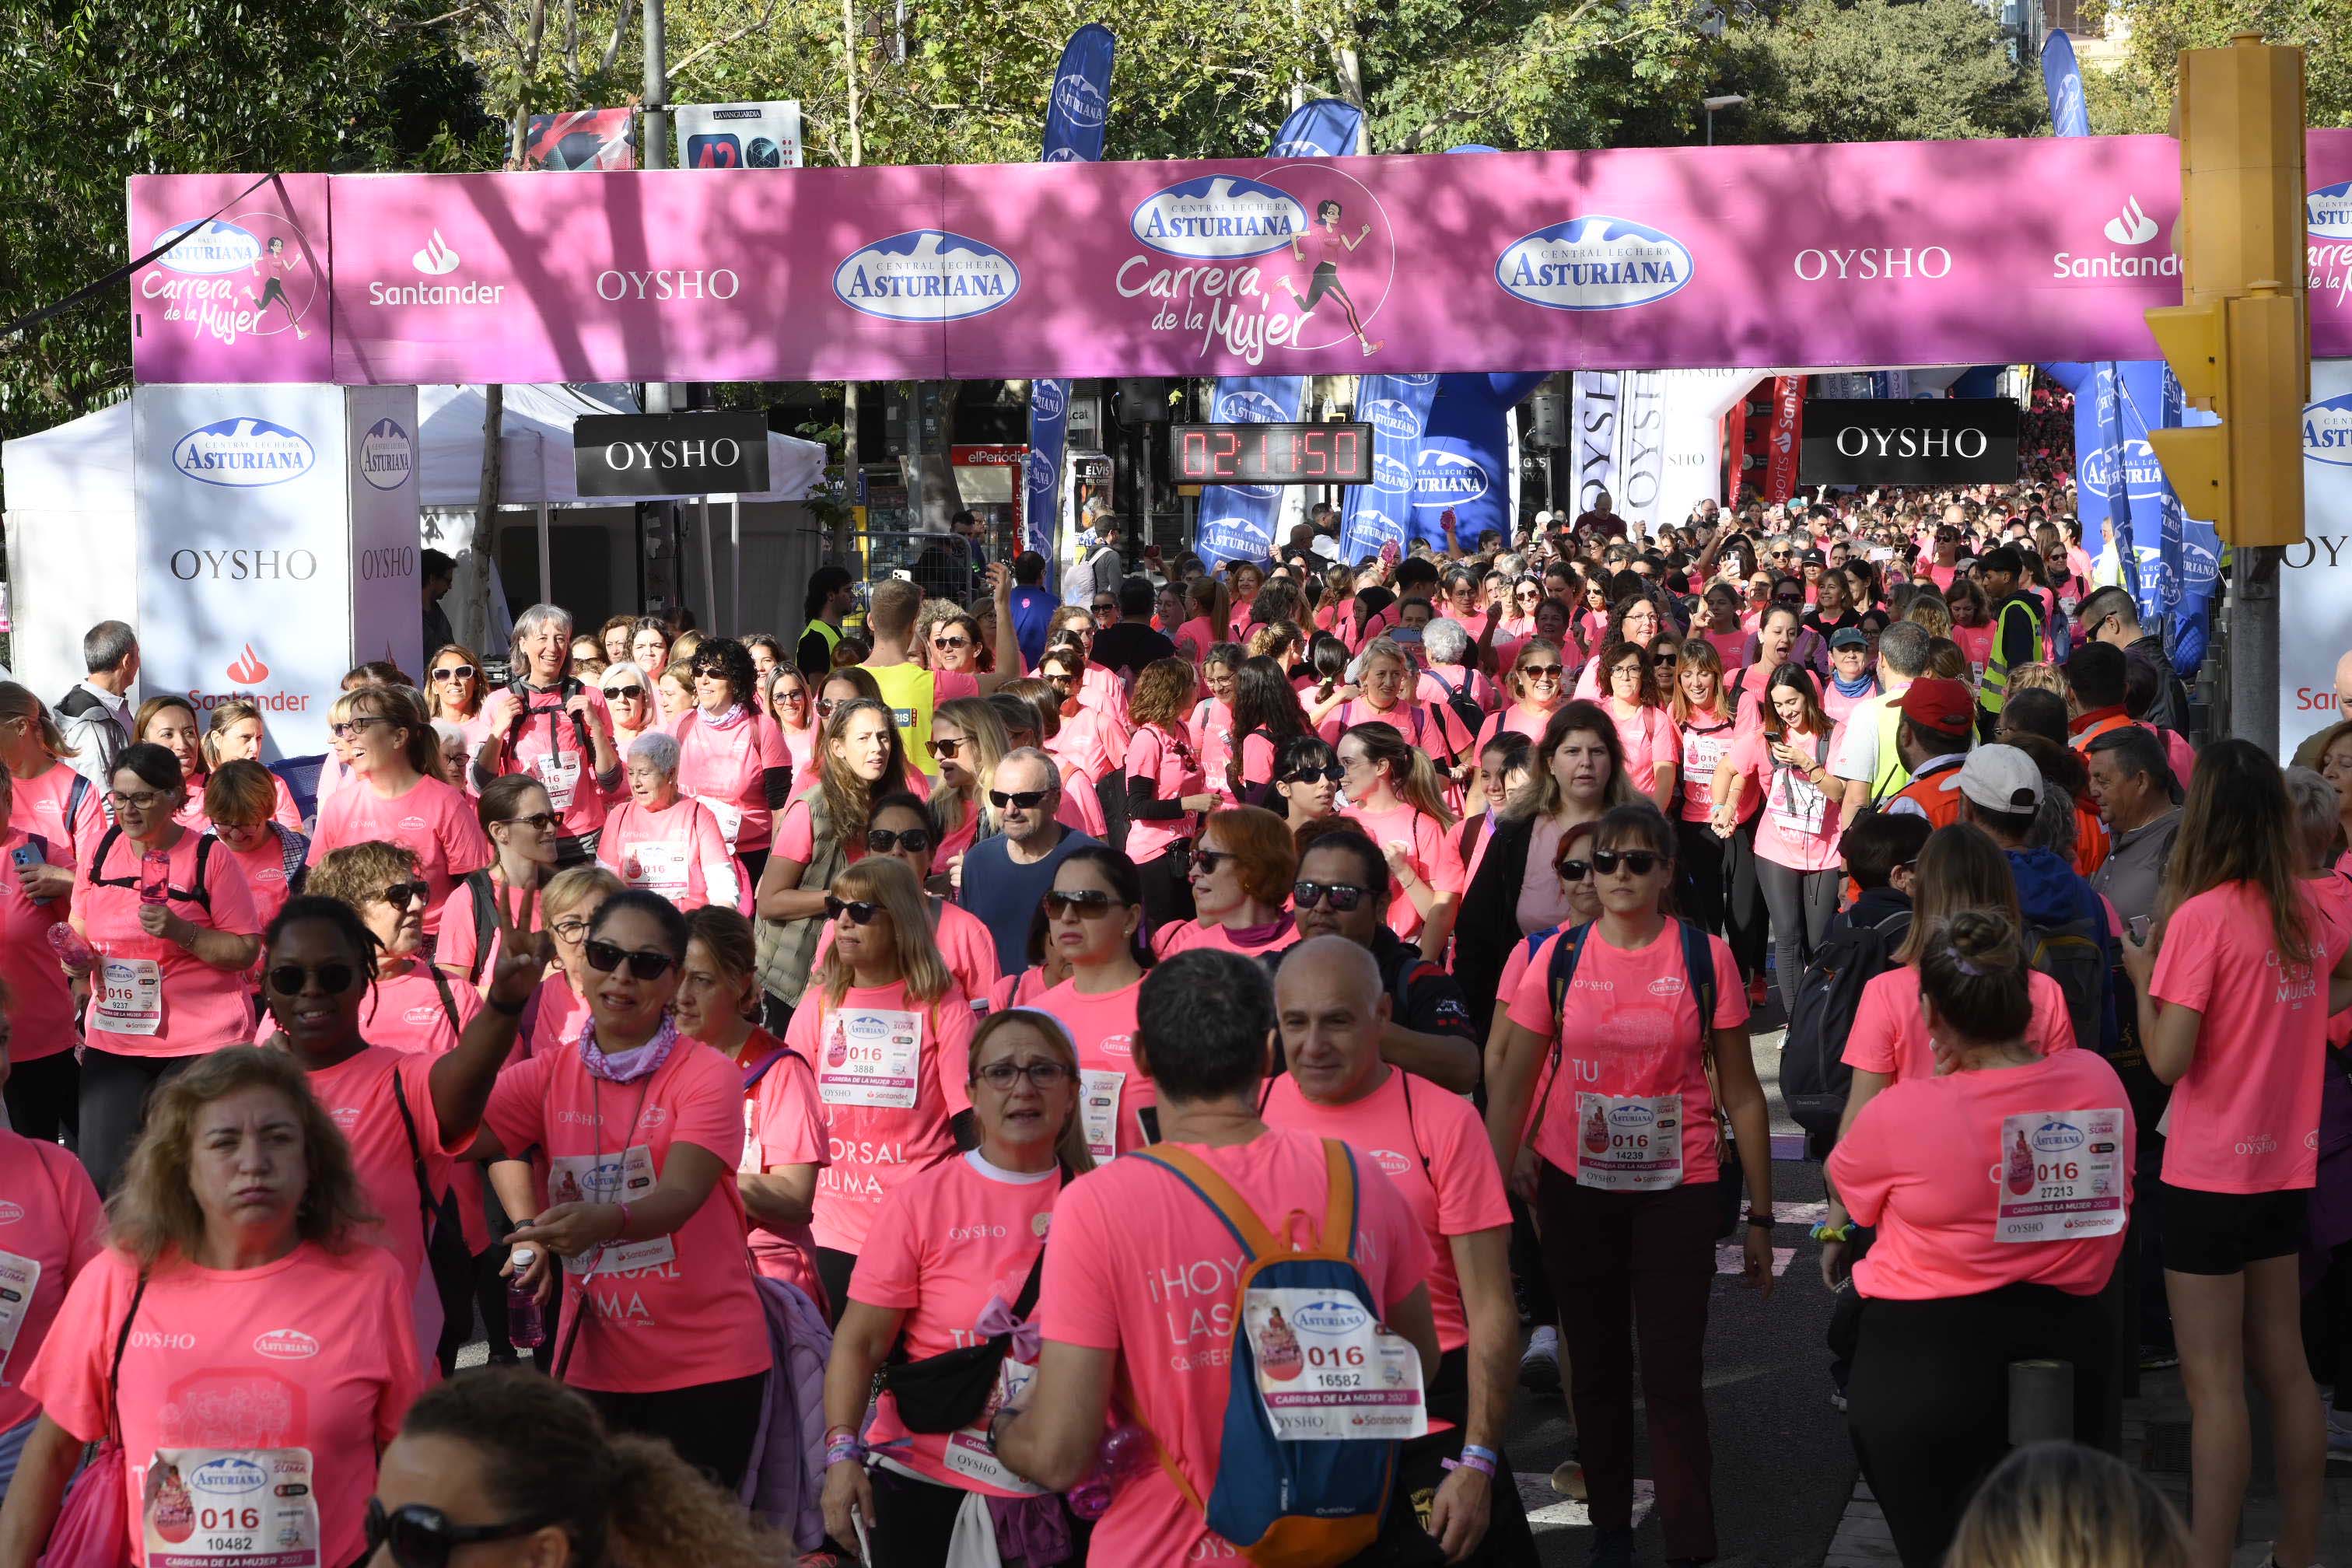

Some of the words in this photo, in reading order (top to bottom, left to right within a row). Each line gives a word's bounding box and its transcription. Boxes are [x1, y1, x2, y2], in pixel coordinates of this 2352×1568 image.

[724, 110, 761, 119] VANGUARDIA
[1171, 204, 1227, 212] CENTRAL
[1233, 203, 1289, 212] LECHERA
[1144, 206, 1293, 239] ASTURIANA
[159, 240, 253, 261] ASTURIANA
[1541, 249, 1602, 259] CENTRAL
[1608, 247, 1671, 257] LECHERA
[1510, 252, 1678, 287] ASTURIANA
[1794, 246, 1951, 281] OYSHO
[142, 271, 232, 299] Carrera
[596, 268, 739, 302] OYSHO
[848, 264, 1006, 299] ASTURIANA
[1115, 255, 1261, 298] Carrera
[2326, 268, 2340, 289] la
[369, 282, 504, 306] Santander
[164, 301, 180, 321] de
[184, 301, 196, 321] la
[1151, 301, 1178, 330] de
[1185, 299, 1203, 330] la
[194, 298, 268, 345] Mujer
[1200, 294, 1316, 366] Mujer
[1364, 409, 1415, 436] ASTURIANA
[1836, 426, 1987, 458] OYSHO
[184, 443, 305, 469] ASTURIANA
[364, 445, 409, 472] ASTURIANA
[605, 438, 739, 471] OYSHO
[1183, 432, 1357, 475] 02:11:50
[1086, 465, 1109, 476] ELVIS
[1205, 528, 1267, 558] ASTURIANA
[170, 549, 317, 580] OYSHO
[362, 546, 413, 580] OYSHO
[109, 988, 132, 999] 016
[1574, 979, 1613, 991] OYSHO
[852, 1024, 886, 1035] ASTURIANA
[849, 1047, 883, 1062] 016
[852, 1064, 874, 1073] 3888
[1572, 1059, 1598, 1083] TU
[824, 1088, 851, 1097] OYSHO
[875, 1090, 908, 1101] Santander
[1612, 1113, 1651, 1122] ASTURIANA
[1612, 1135, 1649, 1148] 016
[2035, 1136, 2080, 1146] ASTURIANA
[2235, 1142, 2277, 1156] OYSHO
[1587, 1172, 1616, 1183] OYSHO
[2037, 1162, 2079, 1182] 016
[2041, 1186, 2074, 1199] 27213
[950, 1225, 1007, 1241] OYSHO
[2007, 1222, 2044, 1234] OYSHO
[2074, 1218, 2115, 1228] Santander
[626, 1246, 663, 1260] Santander
[1167, 1303, 1232, 1345] LAS
[1300, 1312, 1360, 1327] ASTURIANA
[131, 1331, 195, 1350] OYSHO
[257, 1339, 314, 1353] ASTURIANA
[1308, 1346, 1364, 1367] 016
[1318, 1374, 1361, 1388] 16582
[1275, 1395, 1320, 1404] CARRERA
[1323, 1395, 1337, 1403] DE
[1339, 1394, 1352, 1402] LA
[1353, 1394, 1385, 1402] MUJER
[1364, 1416, 1413, 1426] Santander
[273, 1464, 307, 1474] SUMA
[957, 1454, 997, 1475] OYSHO
[197, 1472, 263, 1486] ASTURIANA
[201, 1508, 260, 1530] 016
[207, 1537, 253, 1550] 10482
[165, 1556, 209, 1567] CARRERA
[210, 1557, 225, 1567] DE
[226, 1558, 240, 1567] LA
[242, 1556, 278, 1566] MUJER
